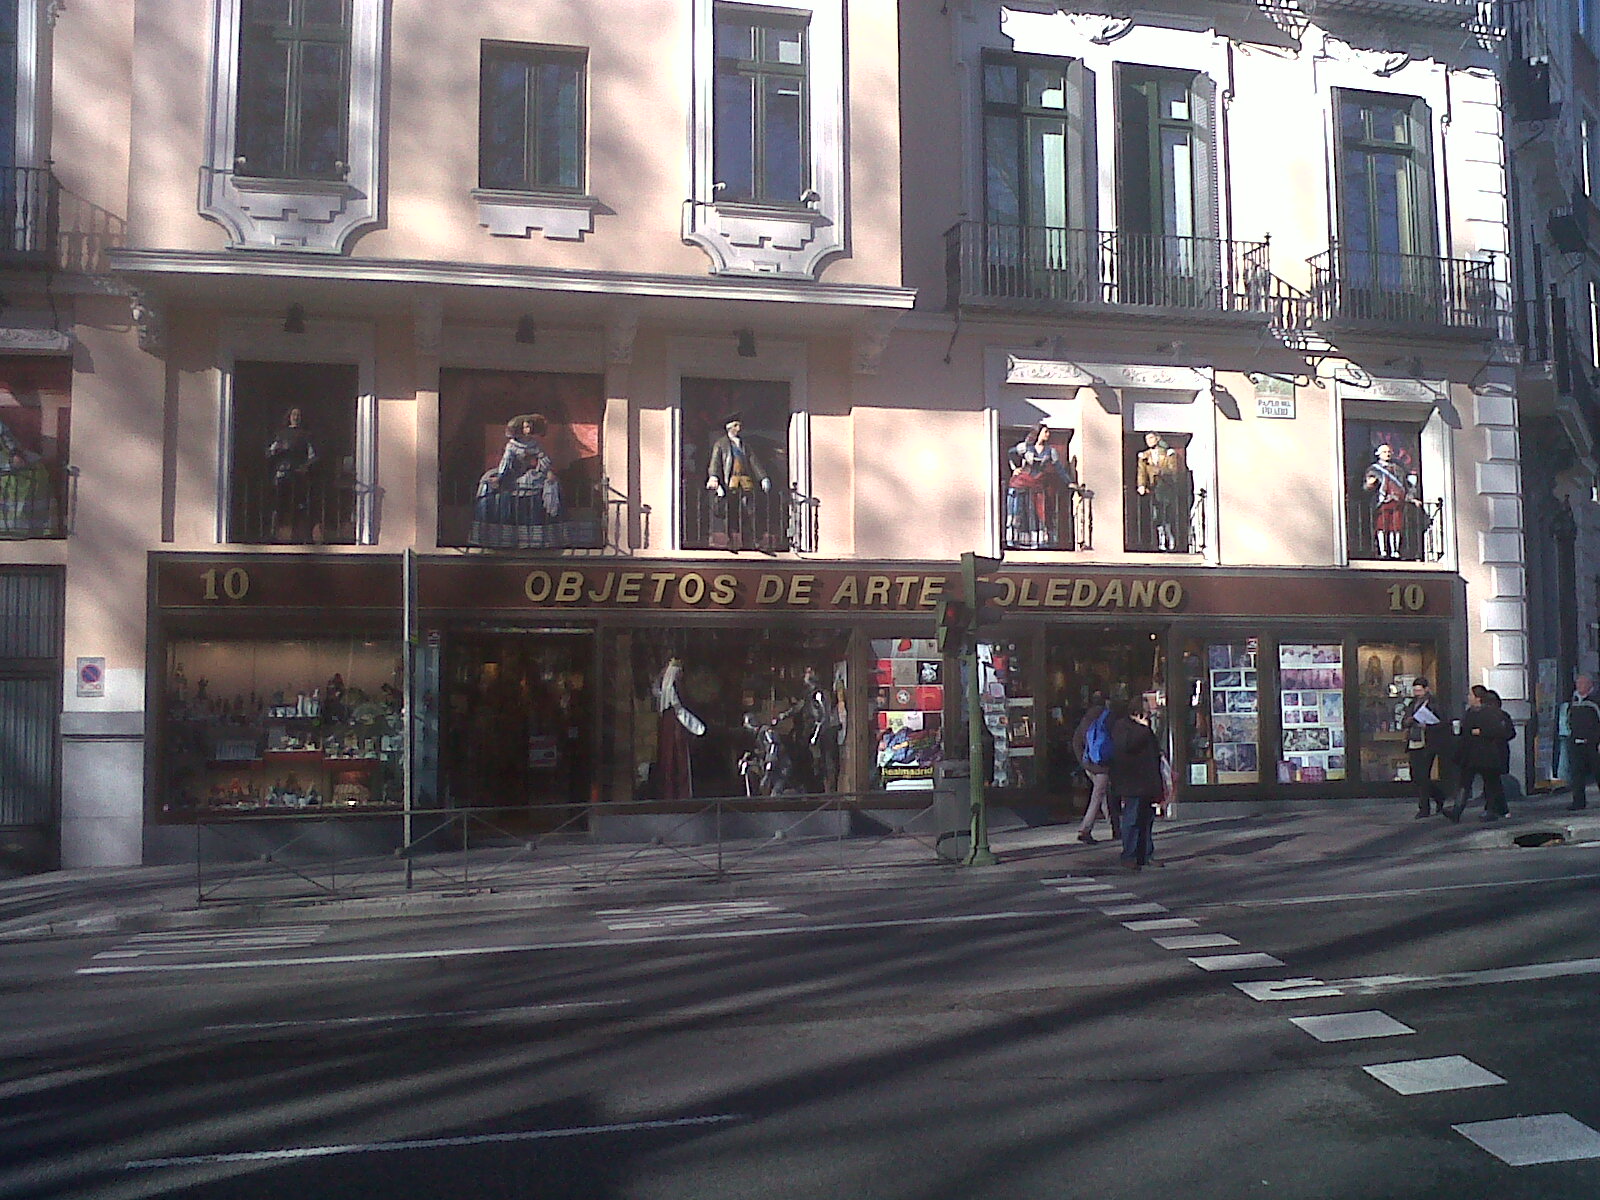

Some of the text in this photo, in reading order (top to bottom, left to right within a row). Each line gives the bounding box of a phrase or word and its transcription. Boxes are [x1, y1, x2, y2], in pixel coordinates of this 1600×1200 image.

[200, 568, 249, 600] 10
[525, 570, 1184, 609] OBJETOS DE ARTE OLEDANO
[1387, 584, 1425, 610] 10
